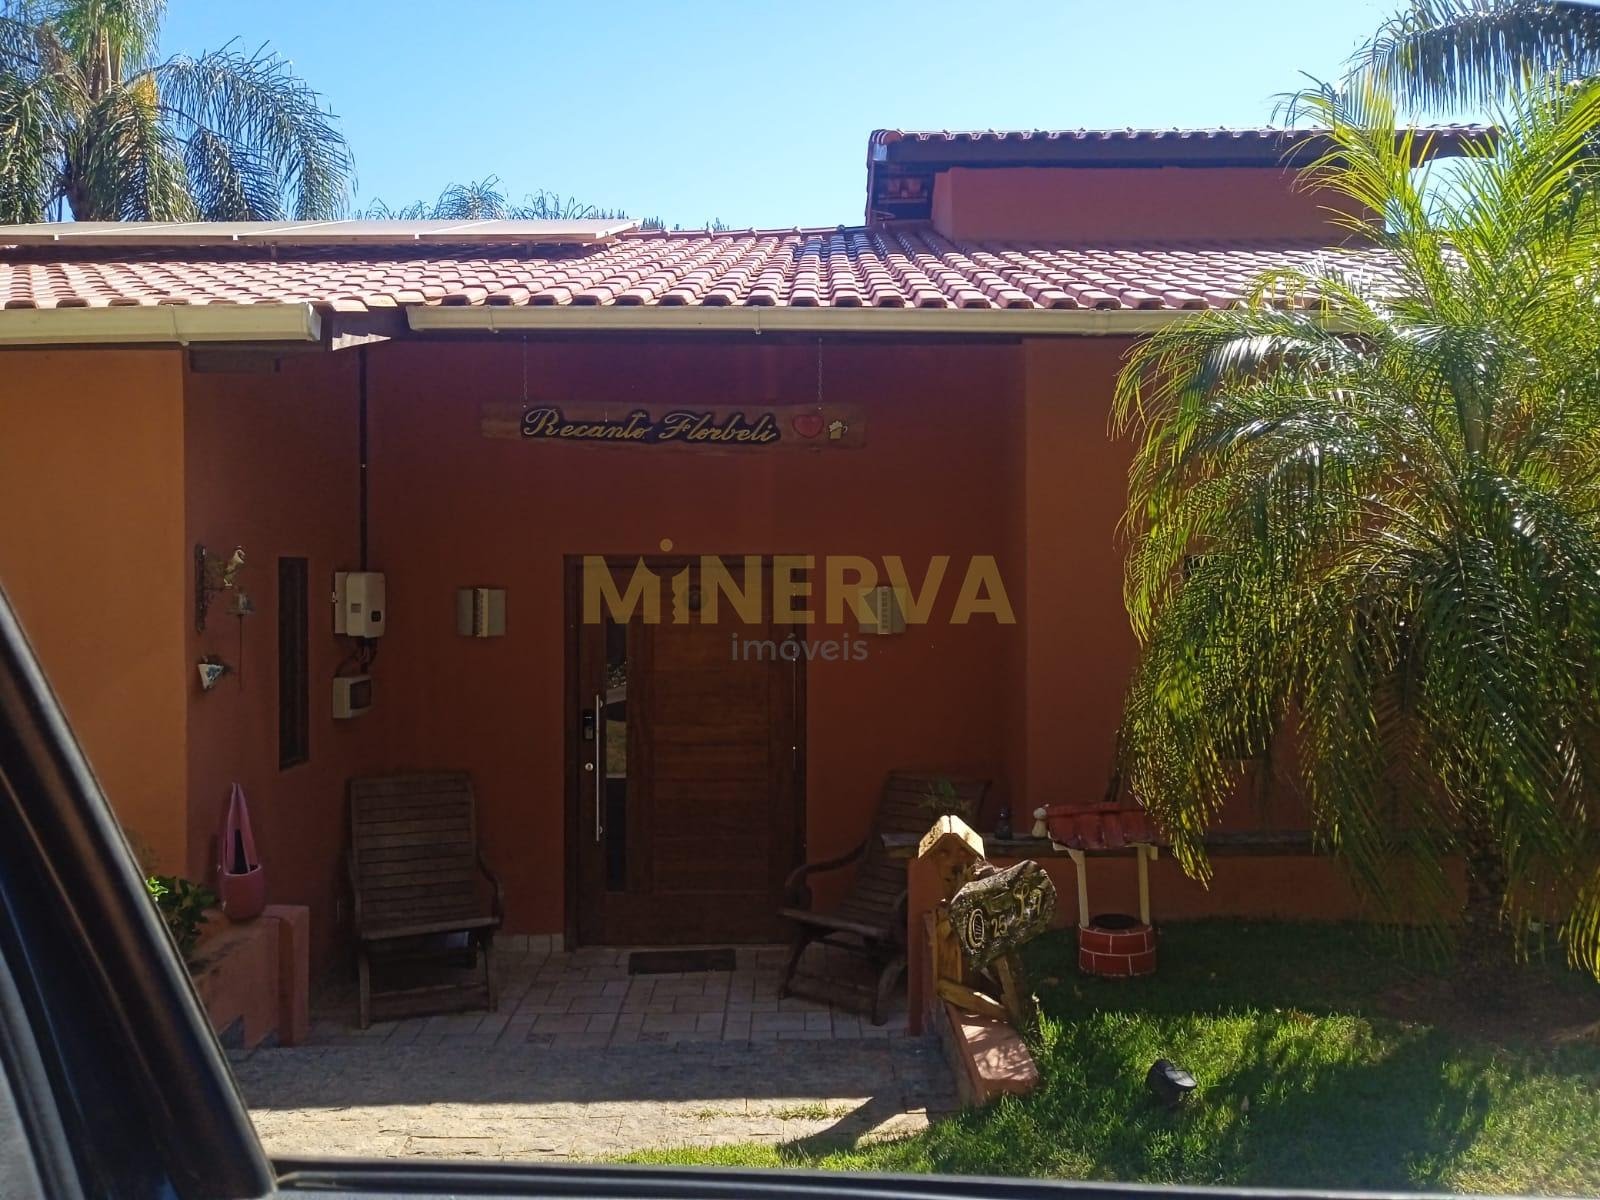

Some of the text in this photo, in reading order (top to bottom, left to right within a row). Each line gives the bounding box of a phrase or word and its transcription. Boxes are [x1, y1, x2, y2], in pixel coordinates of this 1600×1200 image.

[523, 407, 777, 443] Recanto Florbeli
[990, 913, 1008, 938] 25
